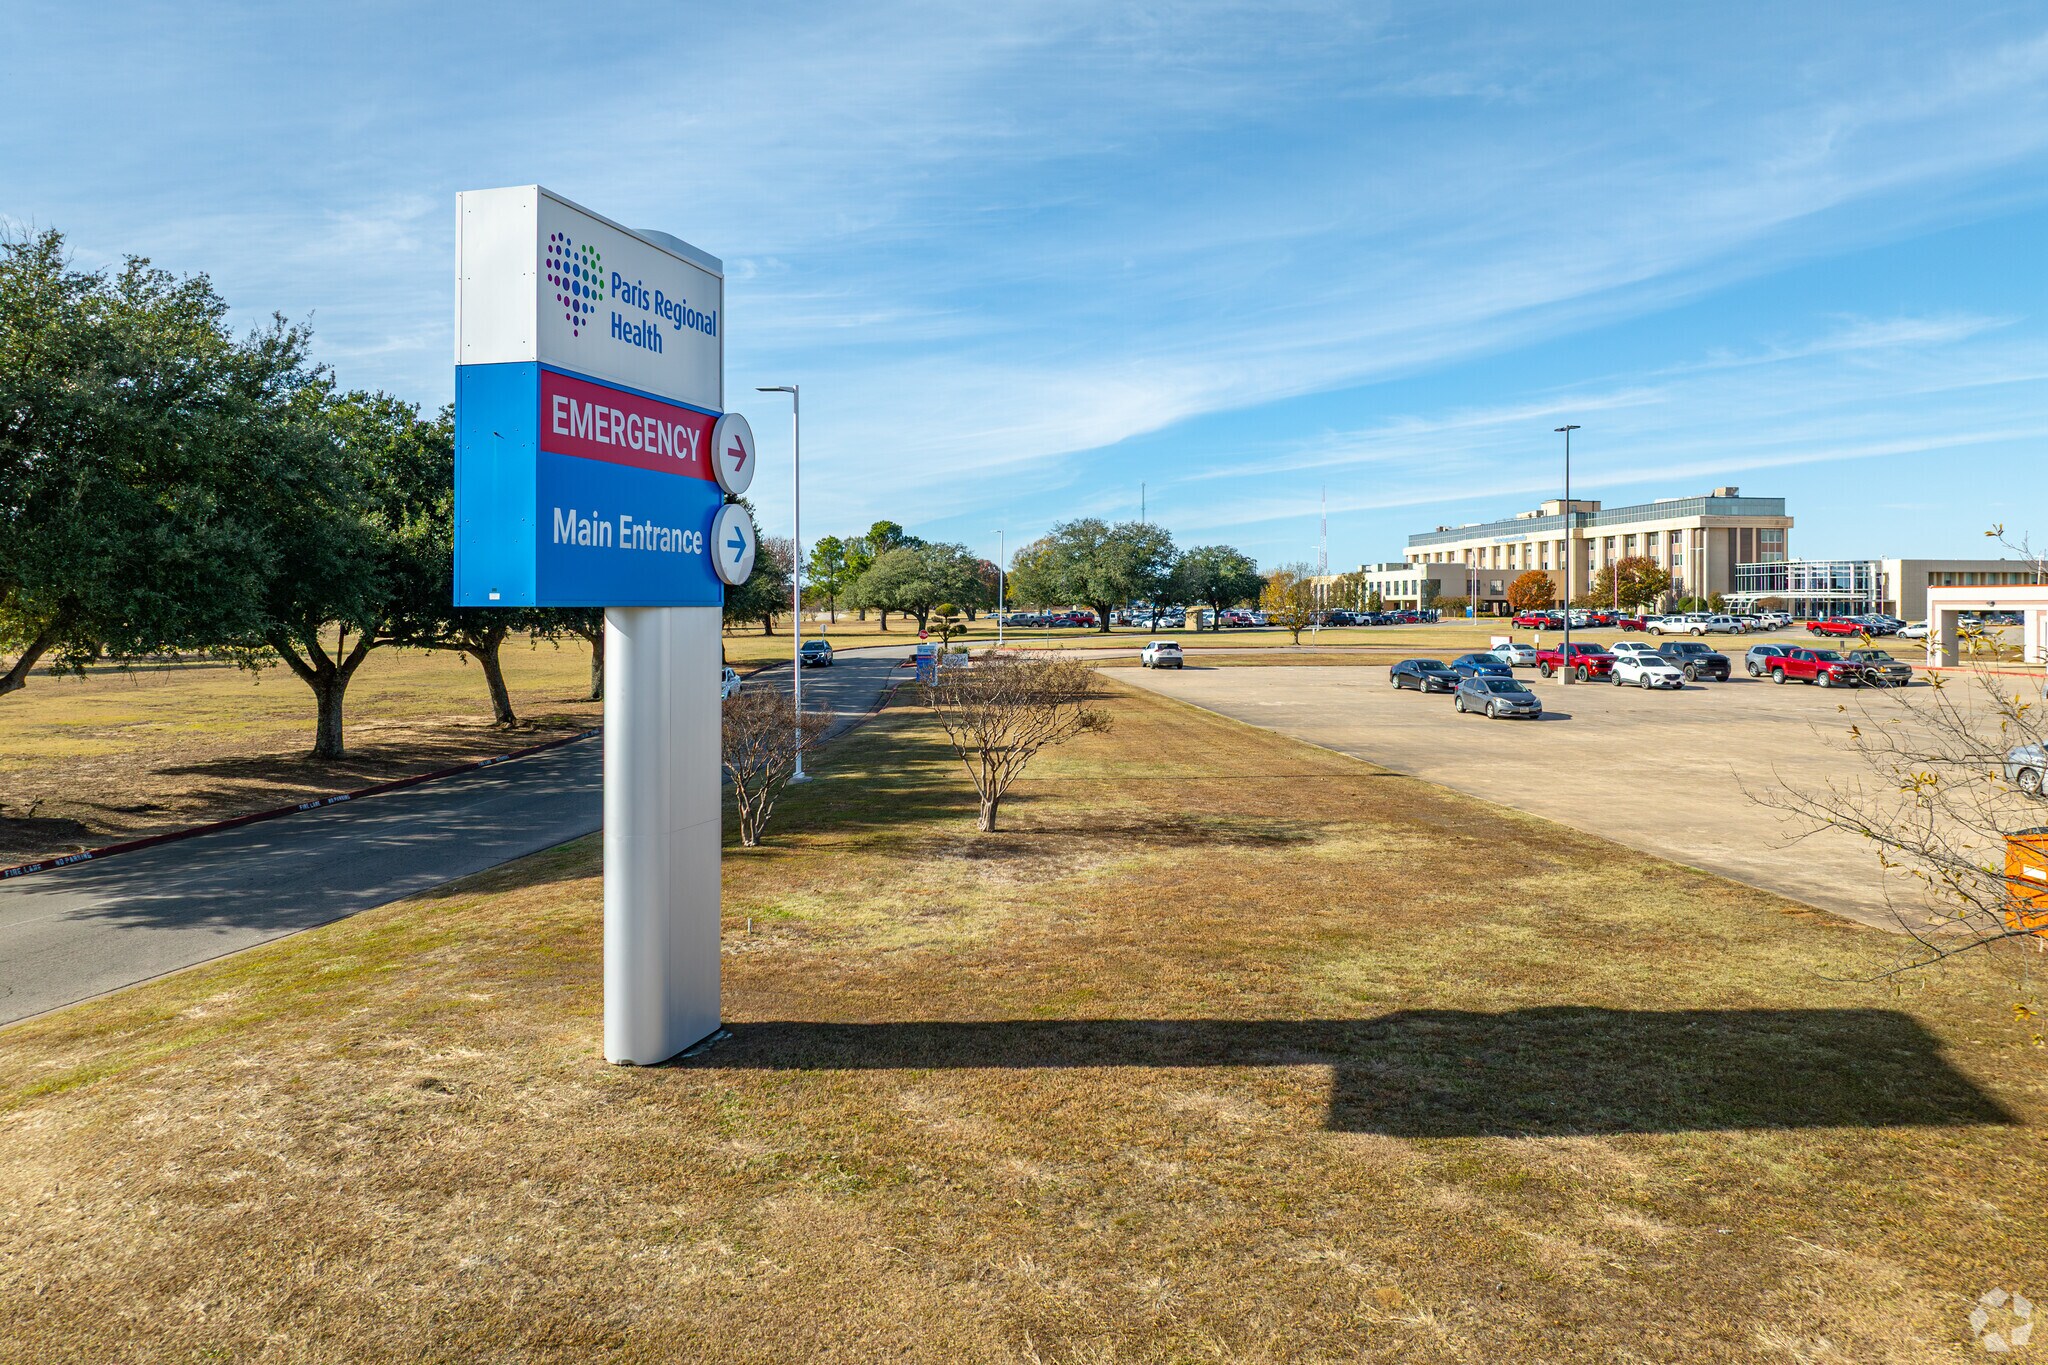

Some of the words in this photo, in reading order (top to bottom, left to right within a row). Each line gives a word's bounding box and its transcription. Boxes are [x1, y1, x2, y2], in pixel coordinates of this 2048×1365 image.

[611, 271, 650, 311] Paris
[654, 289, 717, 337] Regional
[611, 311, 663, 354] Health
[552, 394, 701, 462] EMERGENCY
[553, 507, 613, 548] Main
[619, 514, 704, 555] Entrance
[4, 867, 23, 878] FIRE
[24, 863, 42, 874] LANE
[54, 858, 65, 867] NO
[65, 851, 93, 864] PARKING
